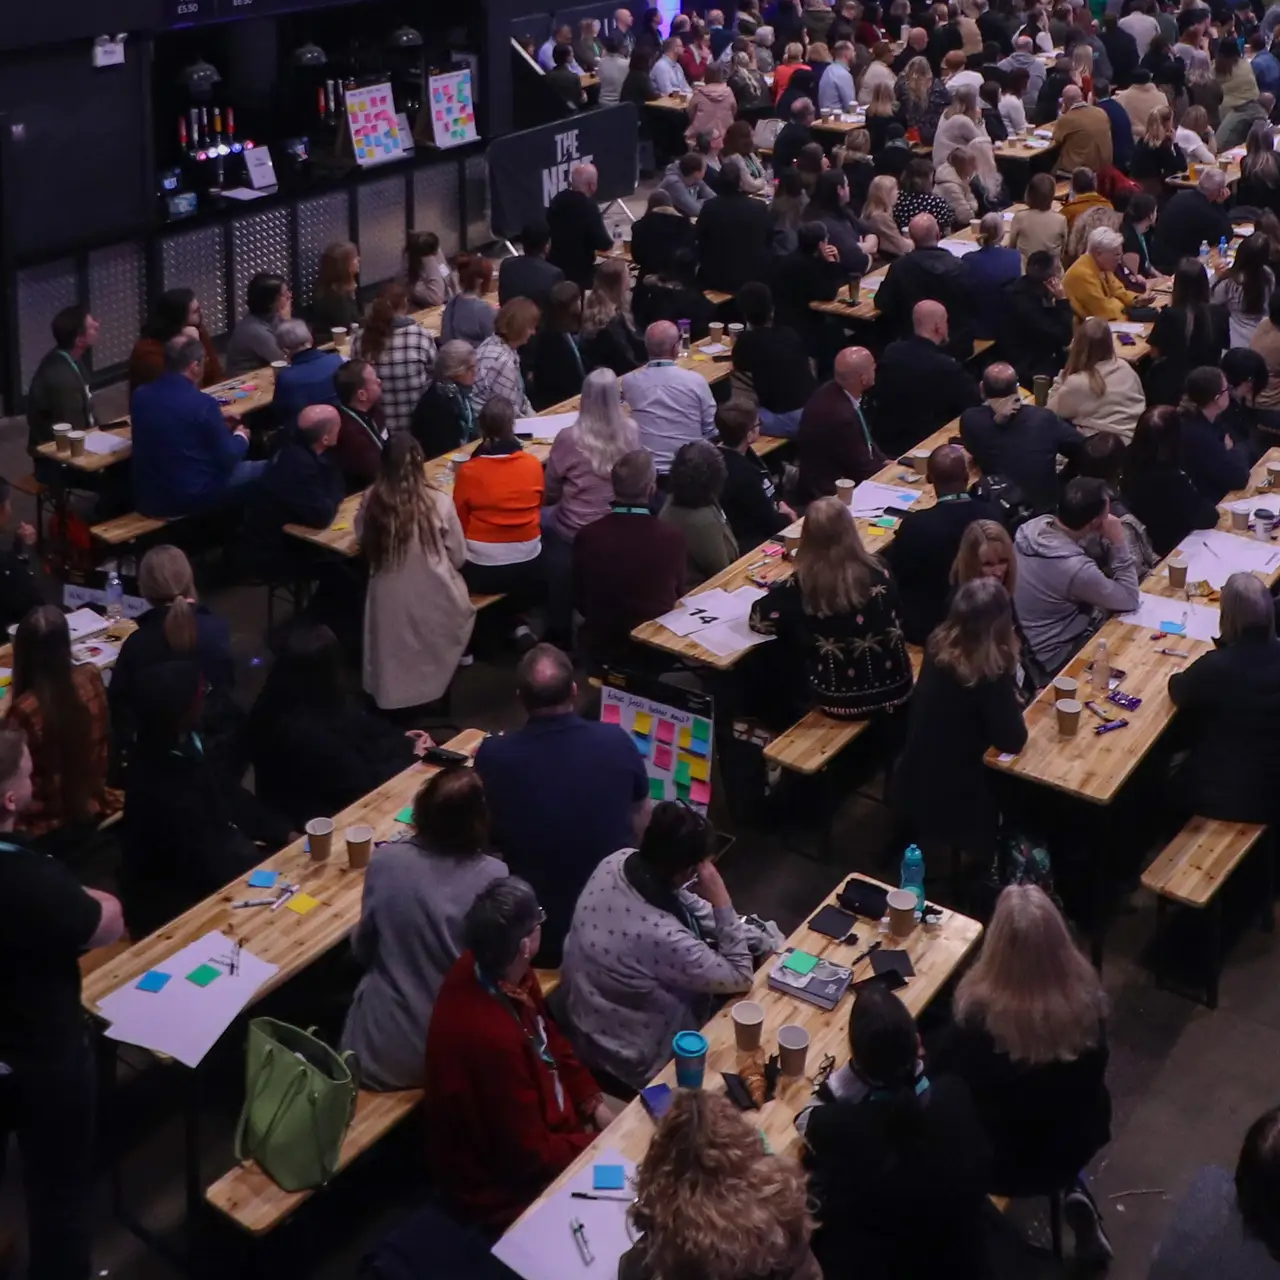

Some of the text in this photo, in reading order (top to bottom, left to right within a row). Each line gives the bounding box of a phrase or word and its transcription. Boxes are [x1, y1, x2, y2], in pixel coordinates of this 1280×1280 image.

[177, 3, 199, 14] £5.50
[554, 128, 581, 163] THE
[541, 154, 594, 208] NE
